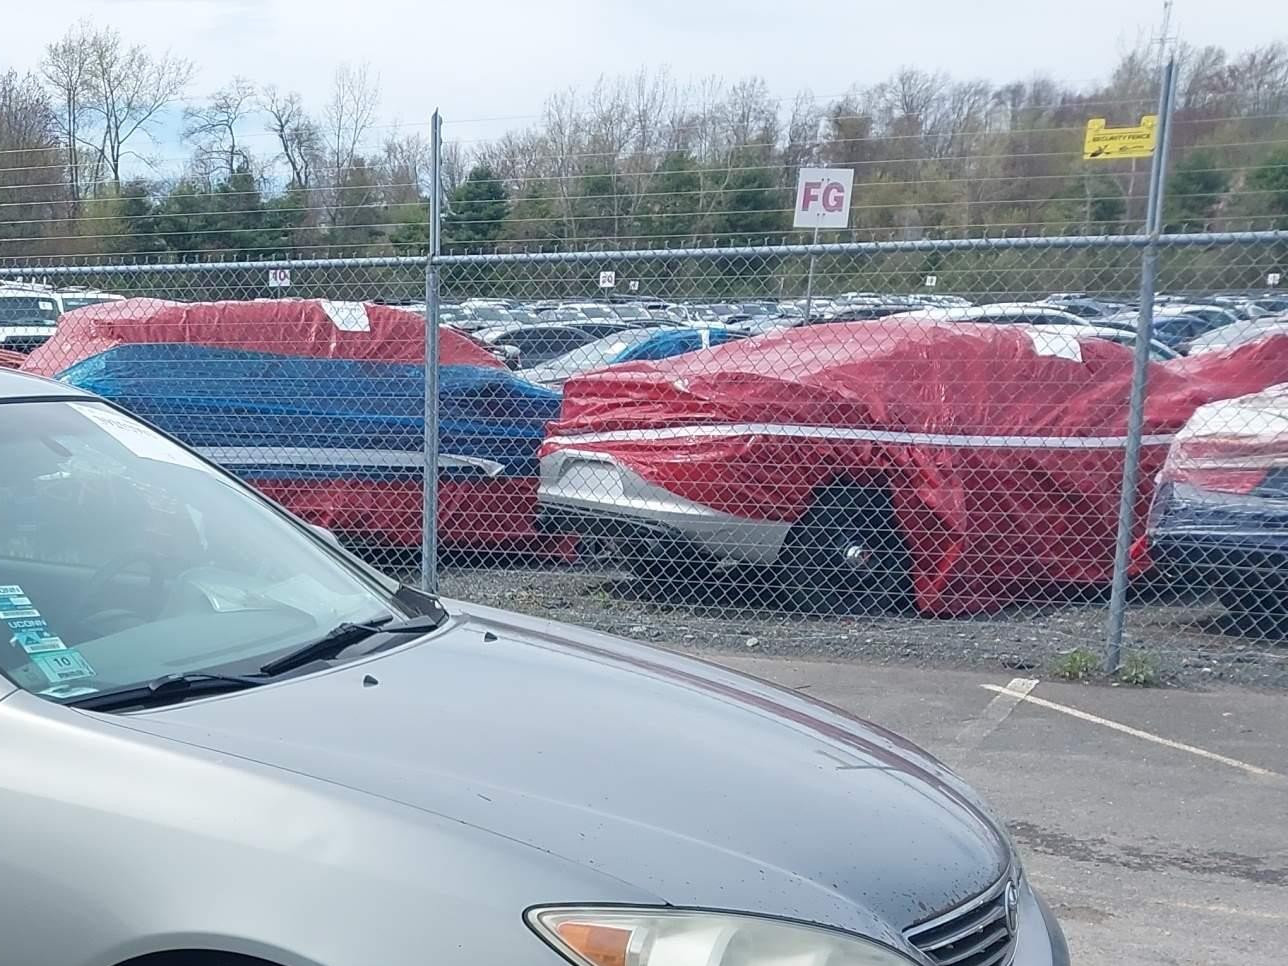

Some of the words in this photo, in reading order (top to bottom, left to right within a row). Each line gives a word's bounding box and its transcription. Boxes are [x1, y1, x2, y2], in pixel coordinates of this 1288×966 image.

[1092, 134, 1127, 142] SECURITY
[1128, 133, 1151, 141] FENCE
[801, 181, 845, 213] FG
[8, 618, 48, 629] UCONN
[54, 656, 72, 668] 10
